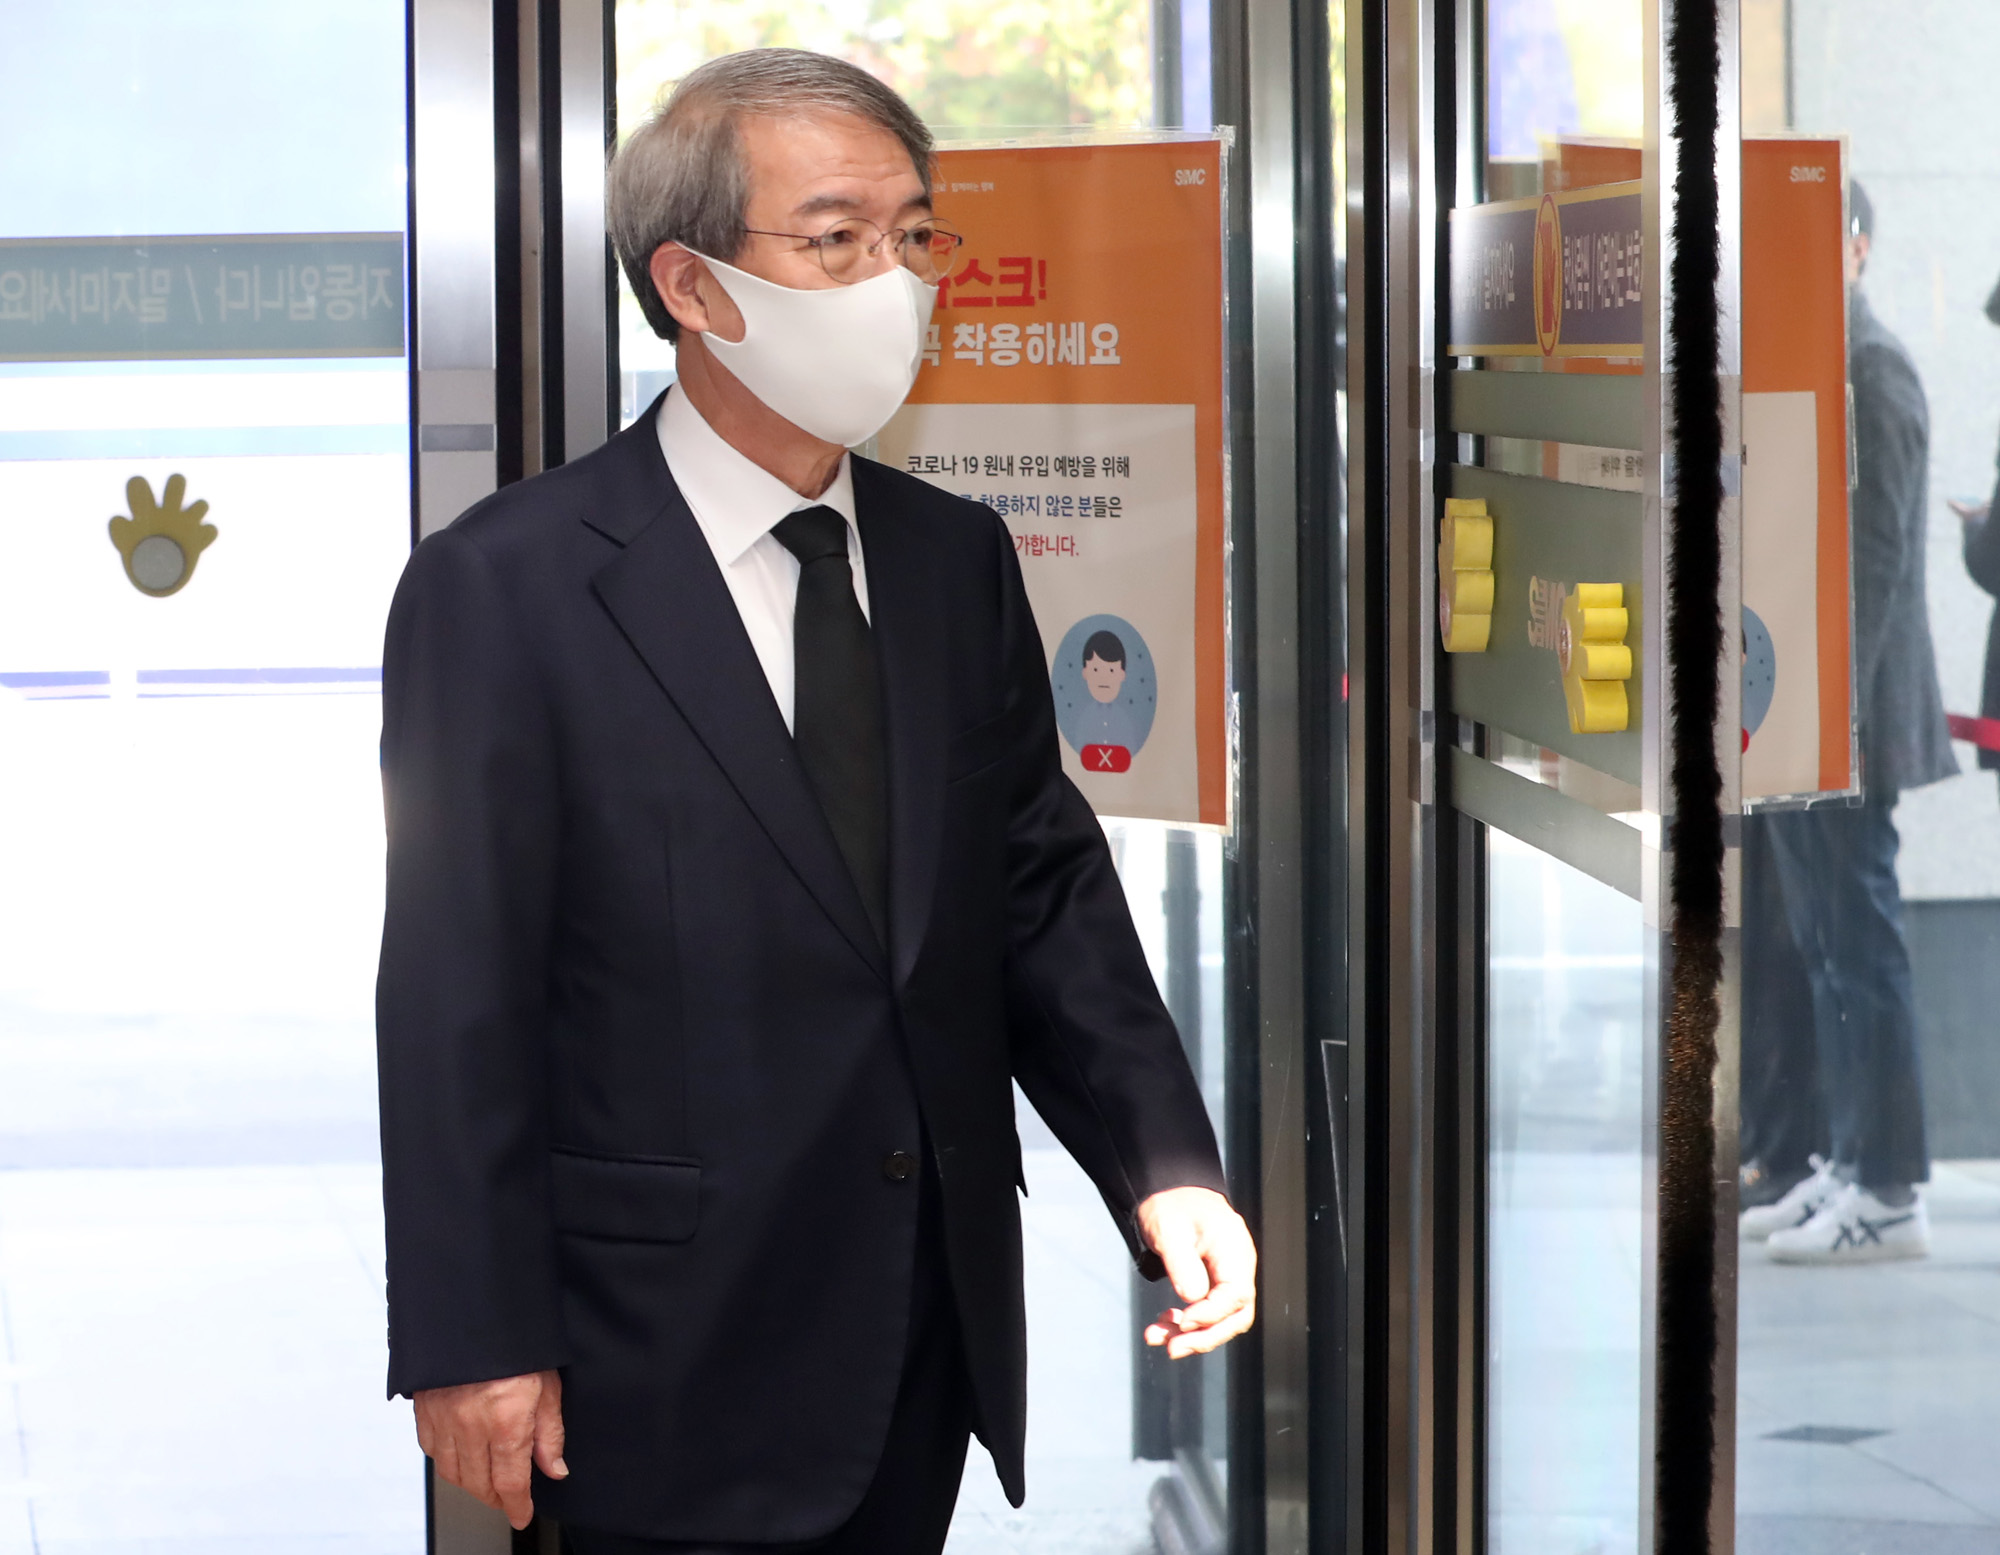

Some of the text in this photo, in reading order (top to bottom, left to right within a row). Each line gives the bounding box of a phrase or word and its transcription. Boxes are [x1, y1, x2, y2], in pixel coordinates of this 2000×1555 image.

[937, 256, 1047, 309] 스크!
[952, 321, 1121, 367] 착용하세요
[906, 455, 1130, 478] 코로나 19 원내 유입 예방을 위해
[1045, 494, 1074, 517] 않은
[1078, 495, 1123, 518] 분들은
[1011, 533, 1080, 557] 가합니다.
